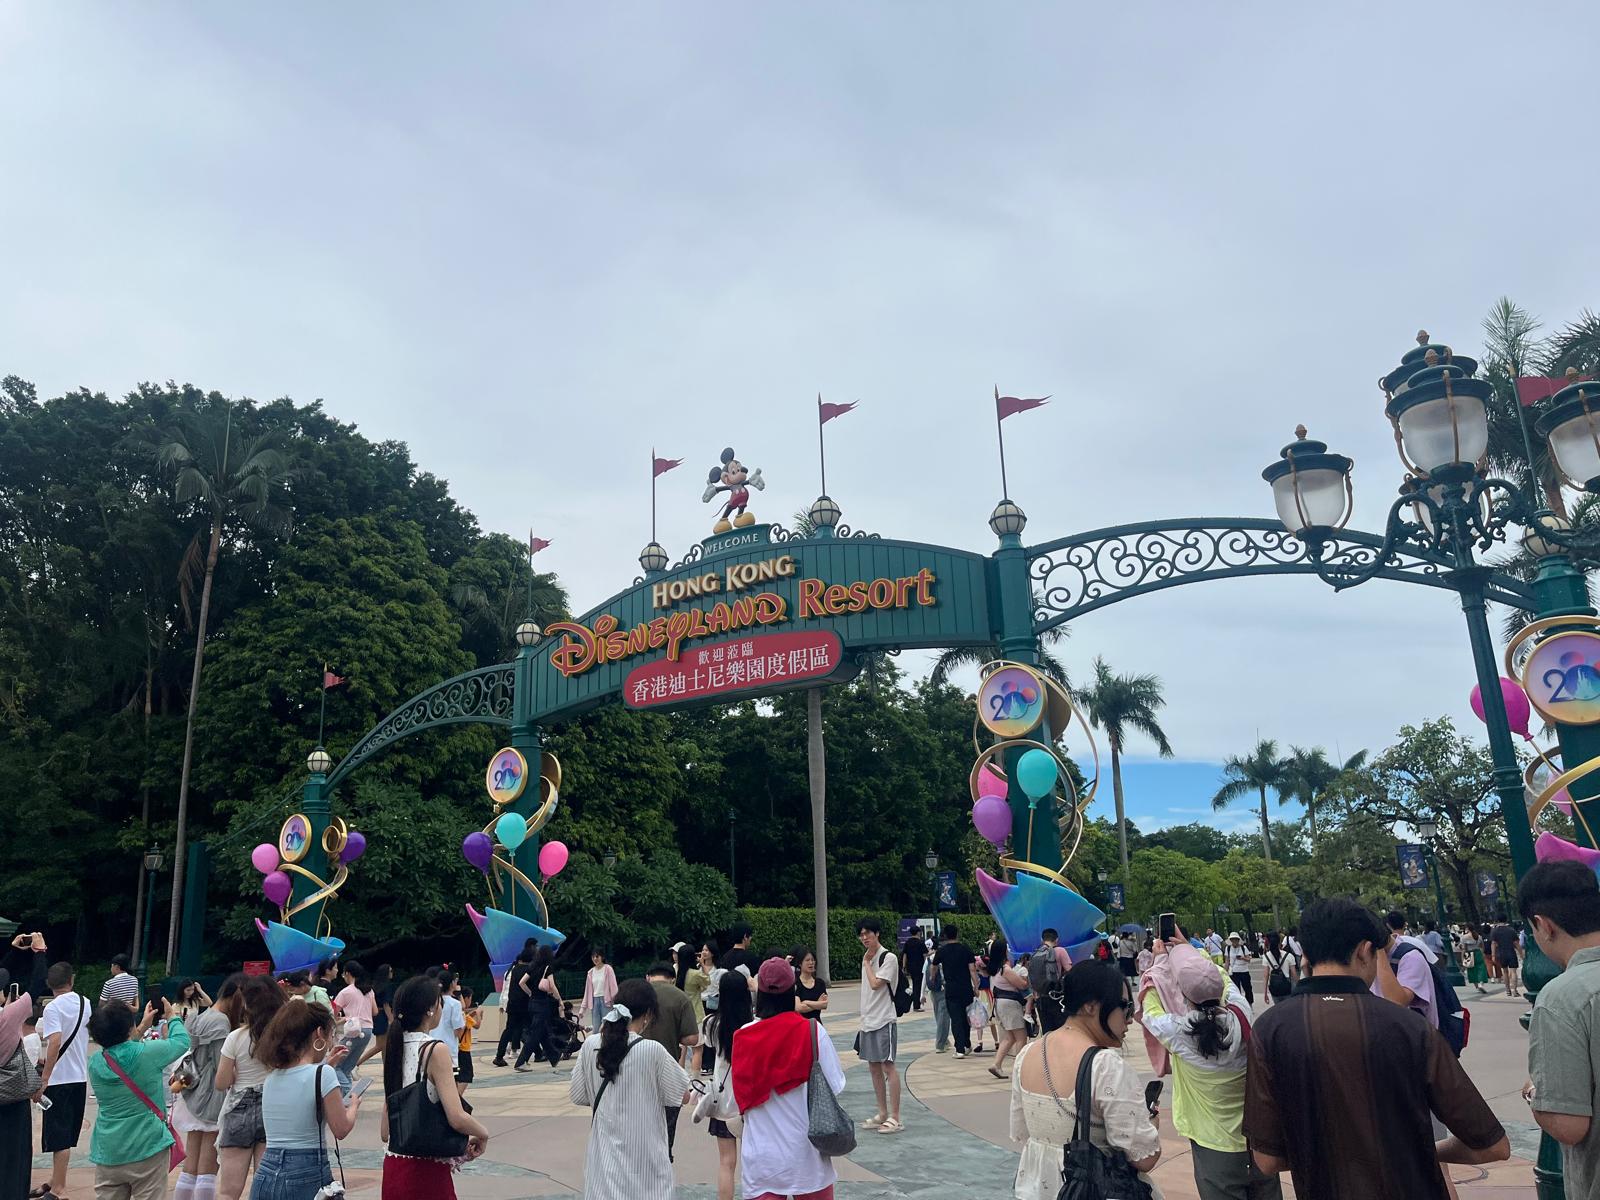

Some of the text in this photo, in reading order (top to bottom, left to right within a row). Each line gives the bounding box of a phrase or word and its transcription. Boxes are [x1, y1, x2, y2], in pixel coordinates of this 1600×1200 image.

[703, 533, 759, 555] WELCOME
[652, 554, 796, 609] HONG KONG
[799, 567, 936, 618] Resort
[632, 643, 830, 703] 香港迪士尼樂園度假區
